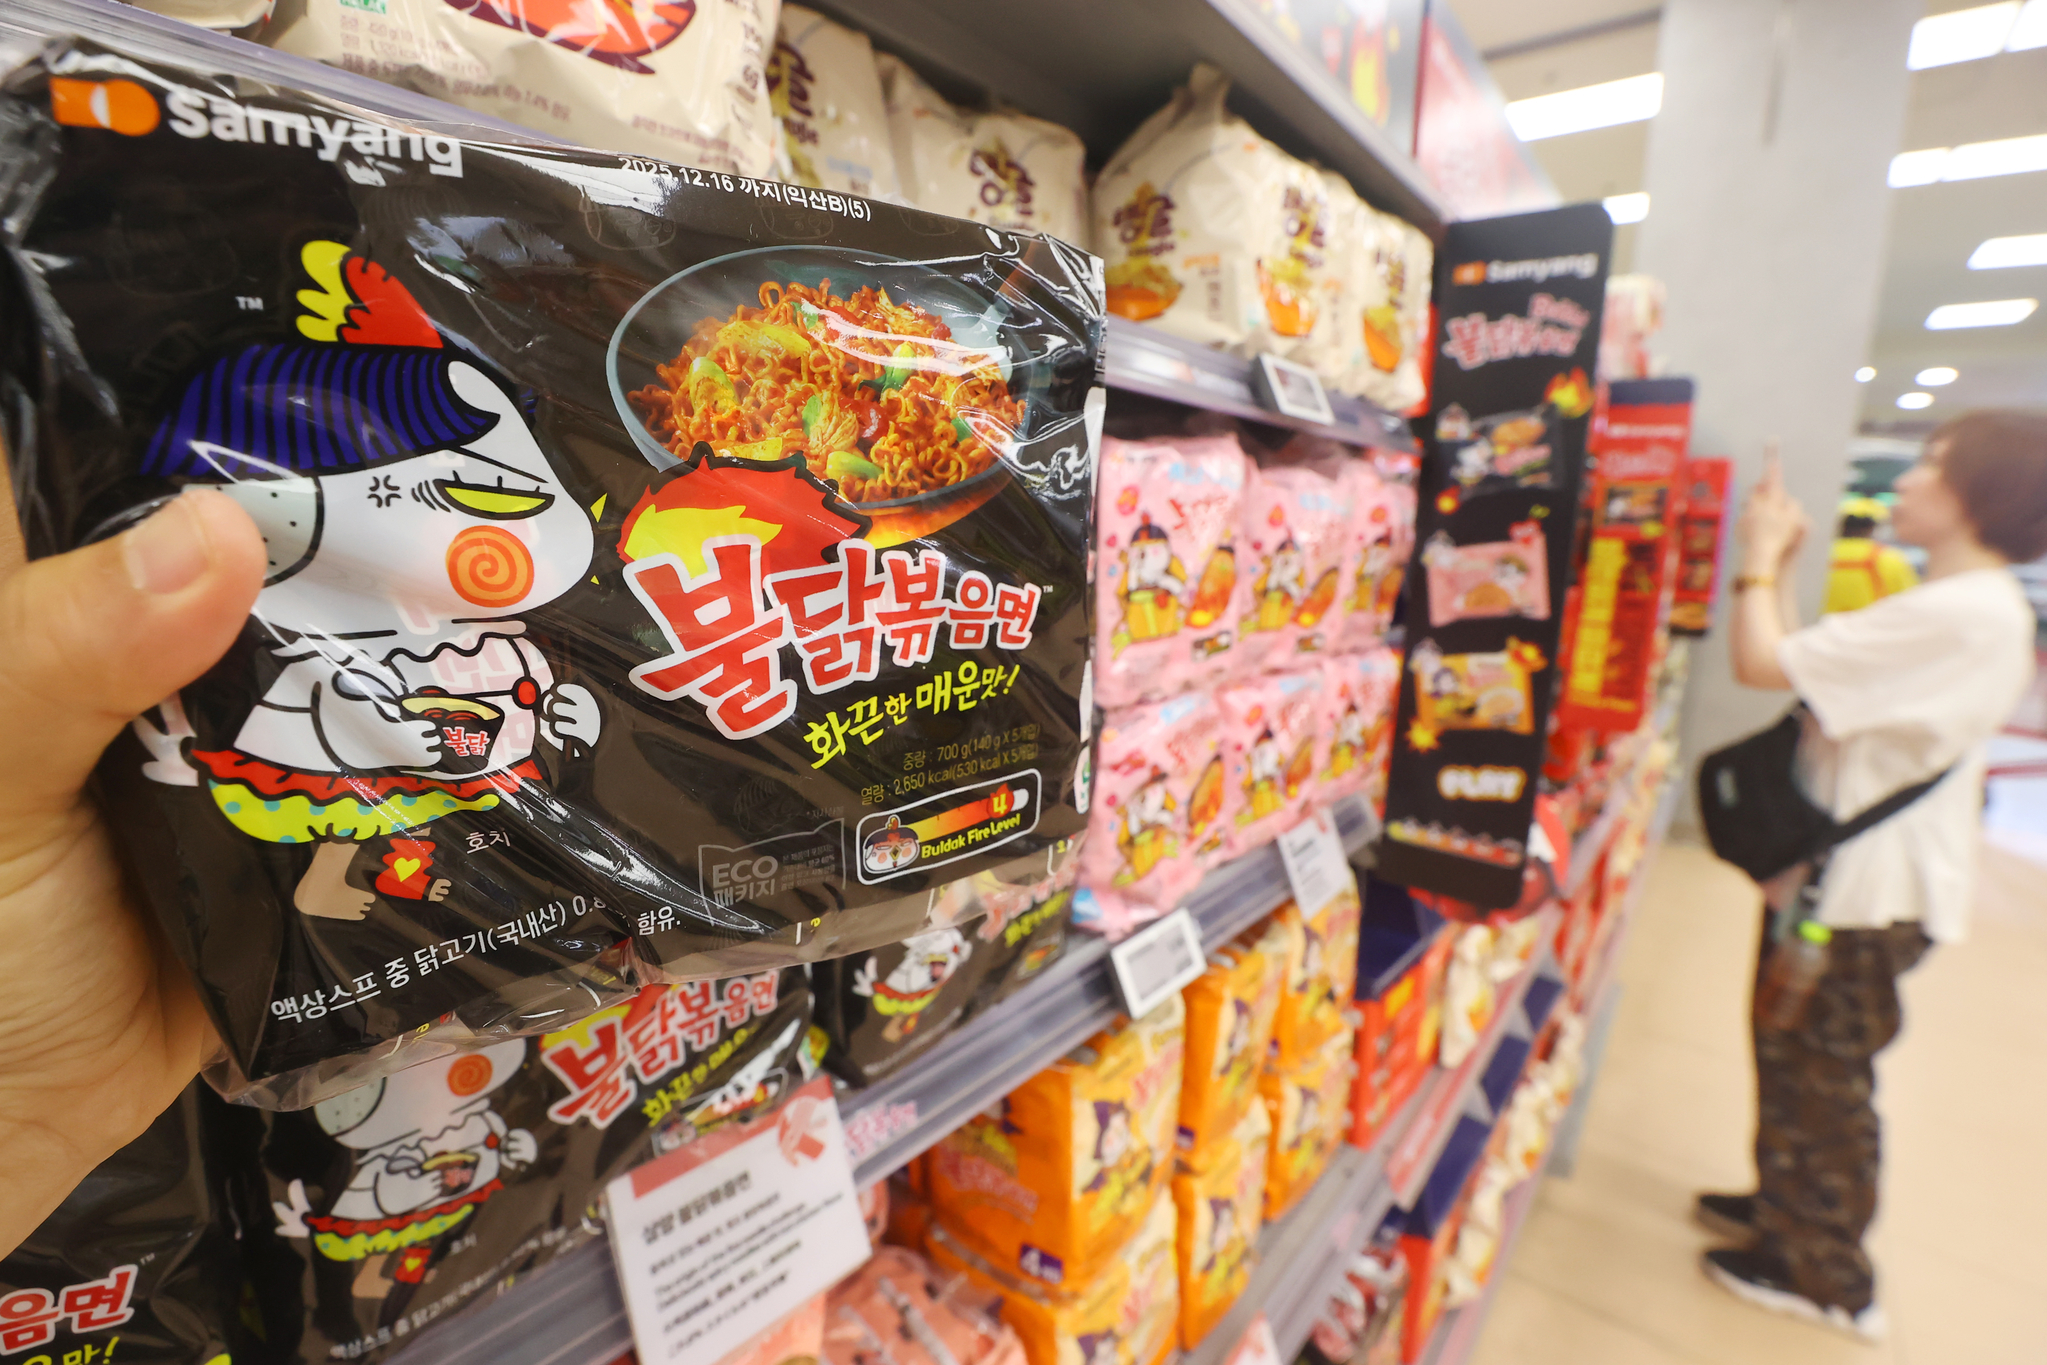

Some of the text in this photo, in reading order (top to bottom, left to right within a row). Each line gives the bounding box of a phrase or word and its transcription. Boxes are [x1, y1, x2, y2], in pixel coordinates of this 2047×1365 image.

[166, 84, 464, 179] Samyang
[618, 157, 735, 193] 2025.12.16
[622, 533, 1043, 740] 불닭볶음면
[442, 726, 490, 757] 불닭
[903, 750, 927, 771] 중량
[937, 743, 959, 763] 700
[861, 783, 885, 806] 열량
[893, 773, 926, 797] 2,650
[992, 792, 1008, 816] 4
[465, 828, 511, 855] 호치
[921, 834, 966, 860] Buldak
[712, 855, 779, 889] ECO
[713, 878, 776, 909] 패키지
[270, 971, 382, 1025] 액상스프
[384, 957, 411, 990] 중
[413, 899, 568, 978] 닭고기(국내산)
[636, 905, 682, 937] 함유.
[541, 968, 780, 1130] 불닭볶음면
[0, 1264, 139, 1356] 음면
